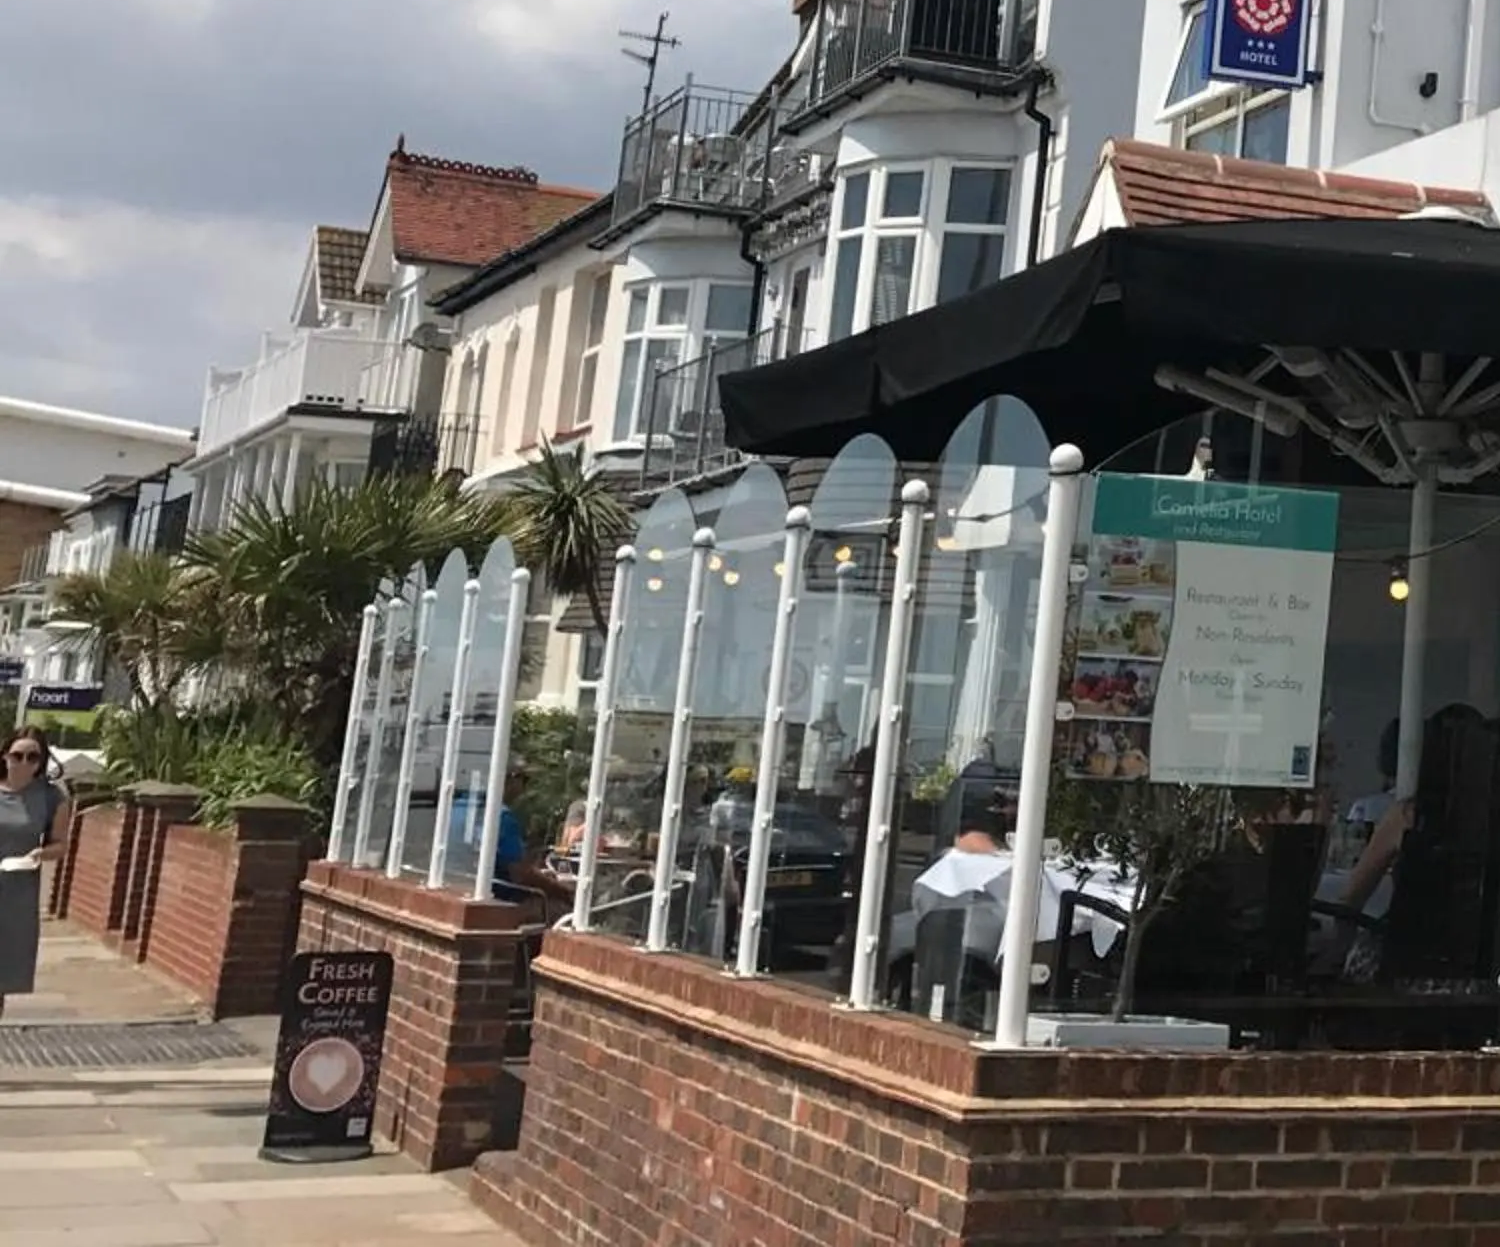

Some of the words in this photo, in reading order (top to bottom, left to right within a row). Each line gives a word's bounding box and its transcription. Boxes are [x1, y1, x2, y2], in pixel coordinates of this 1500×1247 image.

[1239, 50, 1278, 66] HOTEL
[1235, 499, 1282, 523] Hotel
[1187, 586, 1260, 608] Restaurant
[1287, 594, 1312, 611] Bar
[1177, 669, 1236, 689] Monday
[1252, 672, 1304, 695] Sunday
[309, 958, 375, 980] FRESH
[298, 982, 378, 1004] COFFEE
